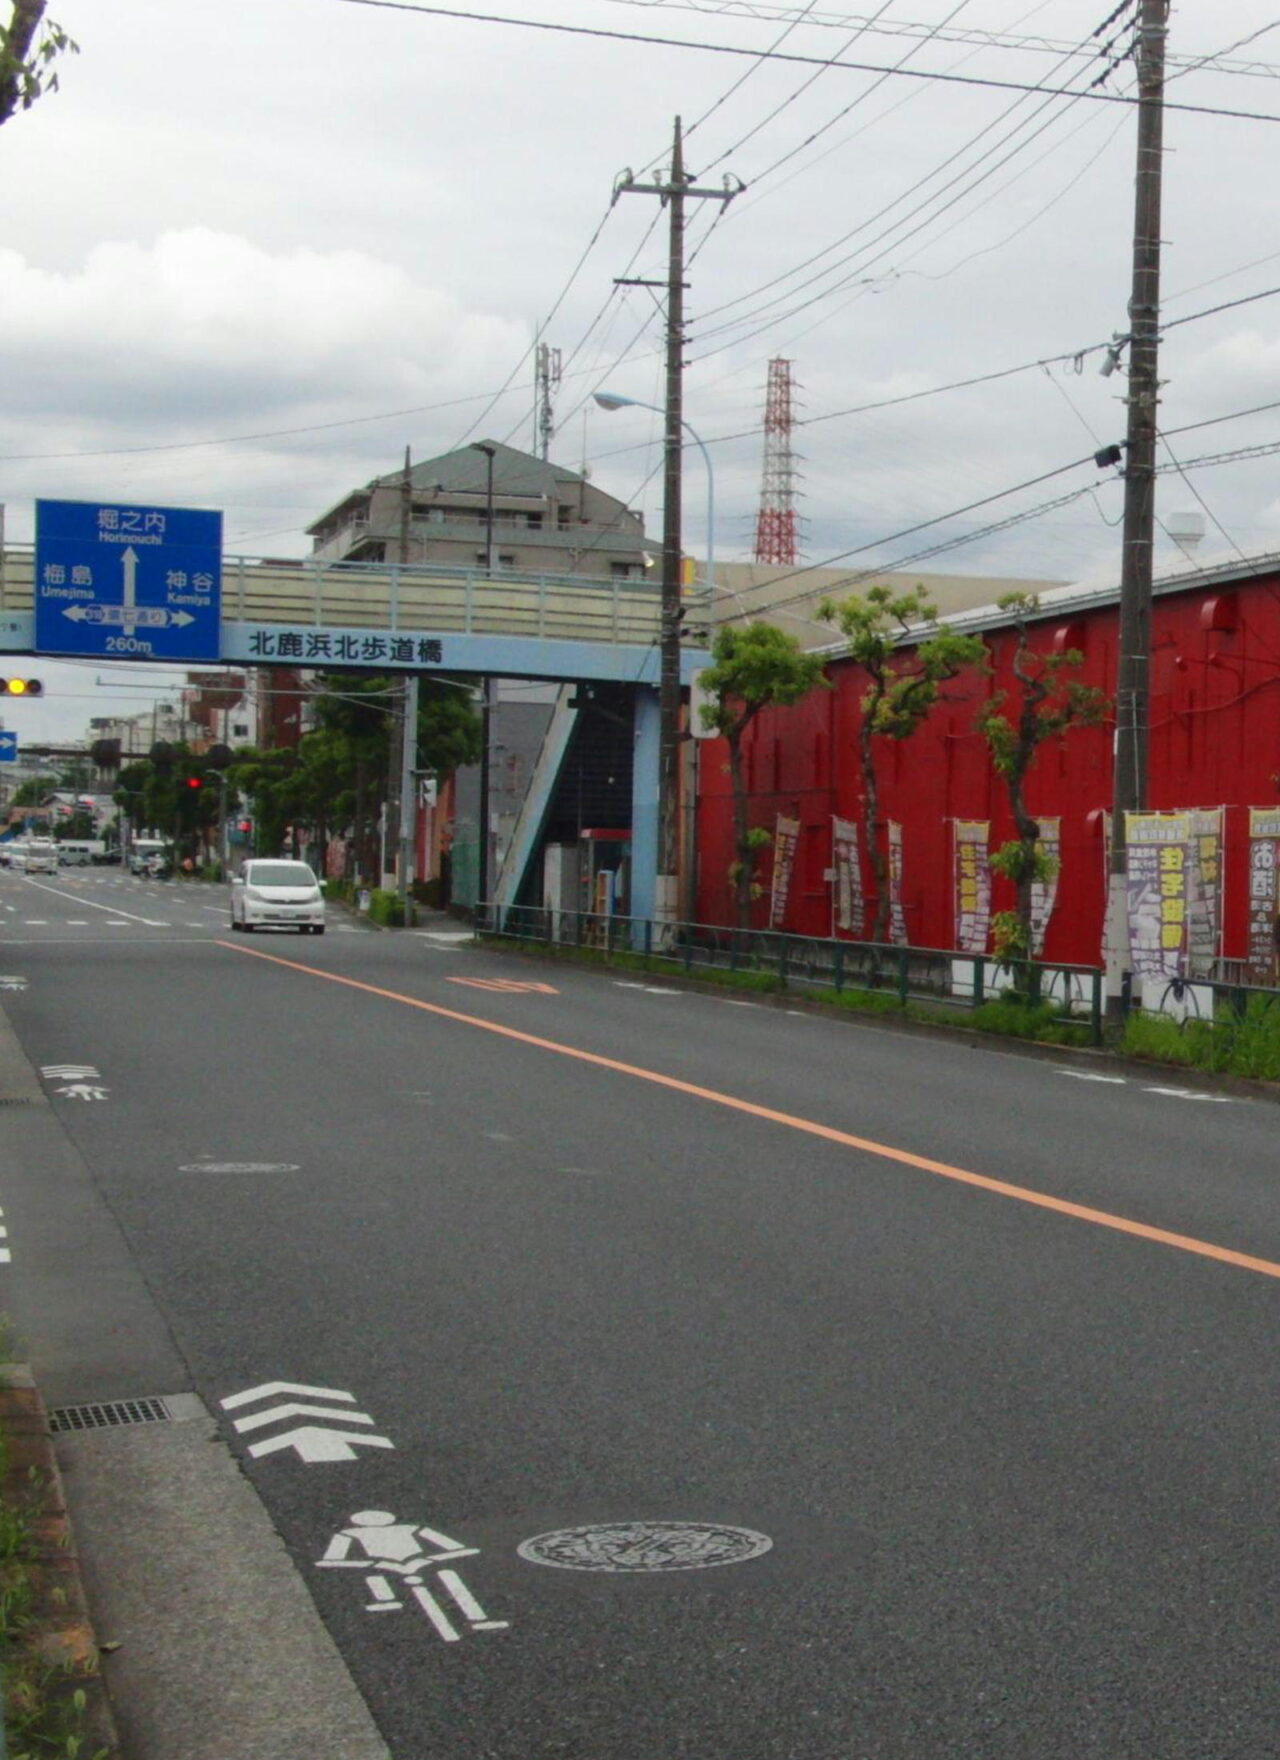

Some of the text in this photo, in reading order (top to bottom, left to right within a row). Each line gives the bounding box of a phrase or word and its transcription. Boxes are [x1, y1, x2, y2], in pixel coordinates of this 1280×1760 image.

[97, 509, 166, 533] 堀之内
[98, 531, 163, 545] Horinouchi
[43, 563, 93, 585] 梅島
[165, 570, 214, 593] 神谷
[41, 585, 95, 600] Umejima
[167, 592, 211, 606] Kamiya
[105, 636, 152, 653] 260m
[248, 630, 443, 664] 北鹿浜北歩道橋
